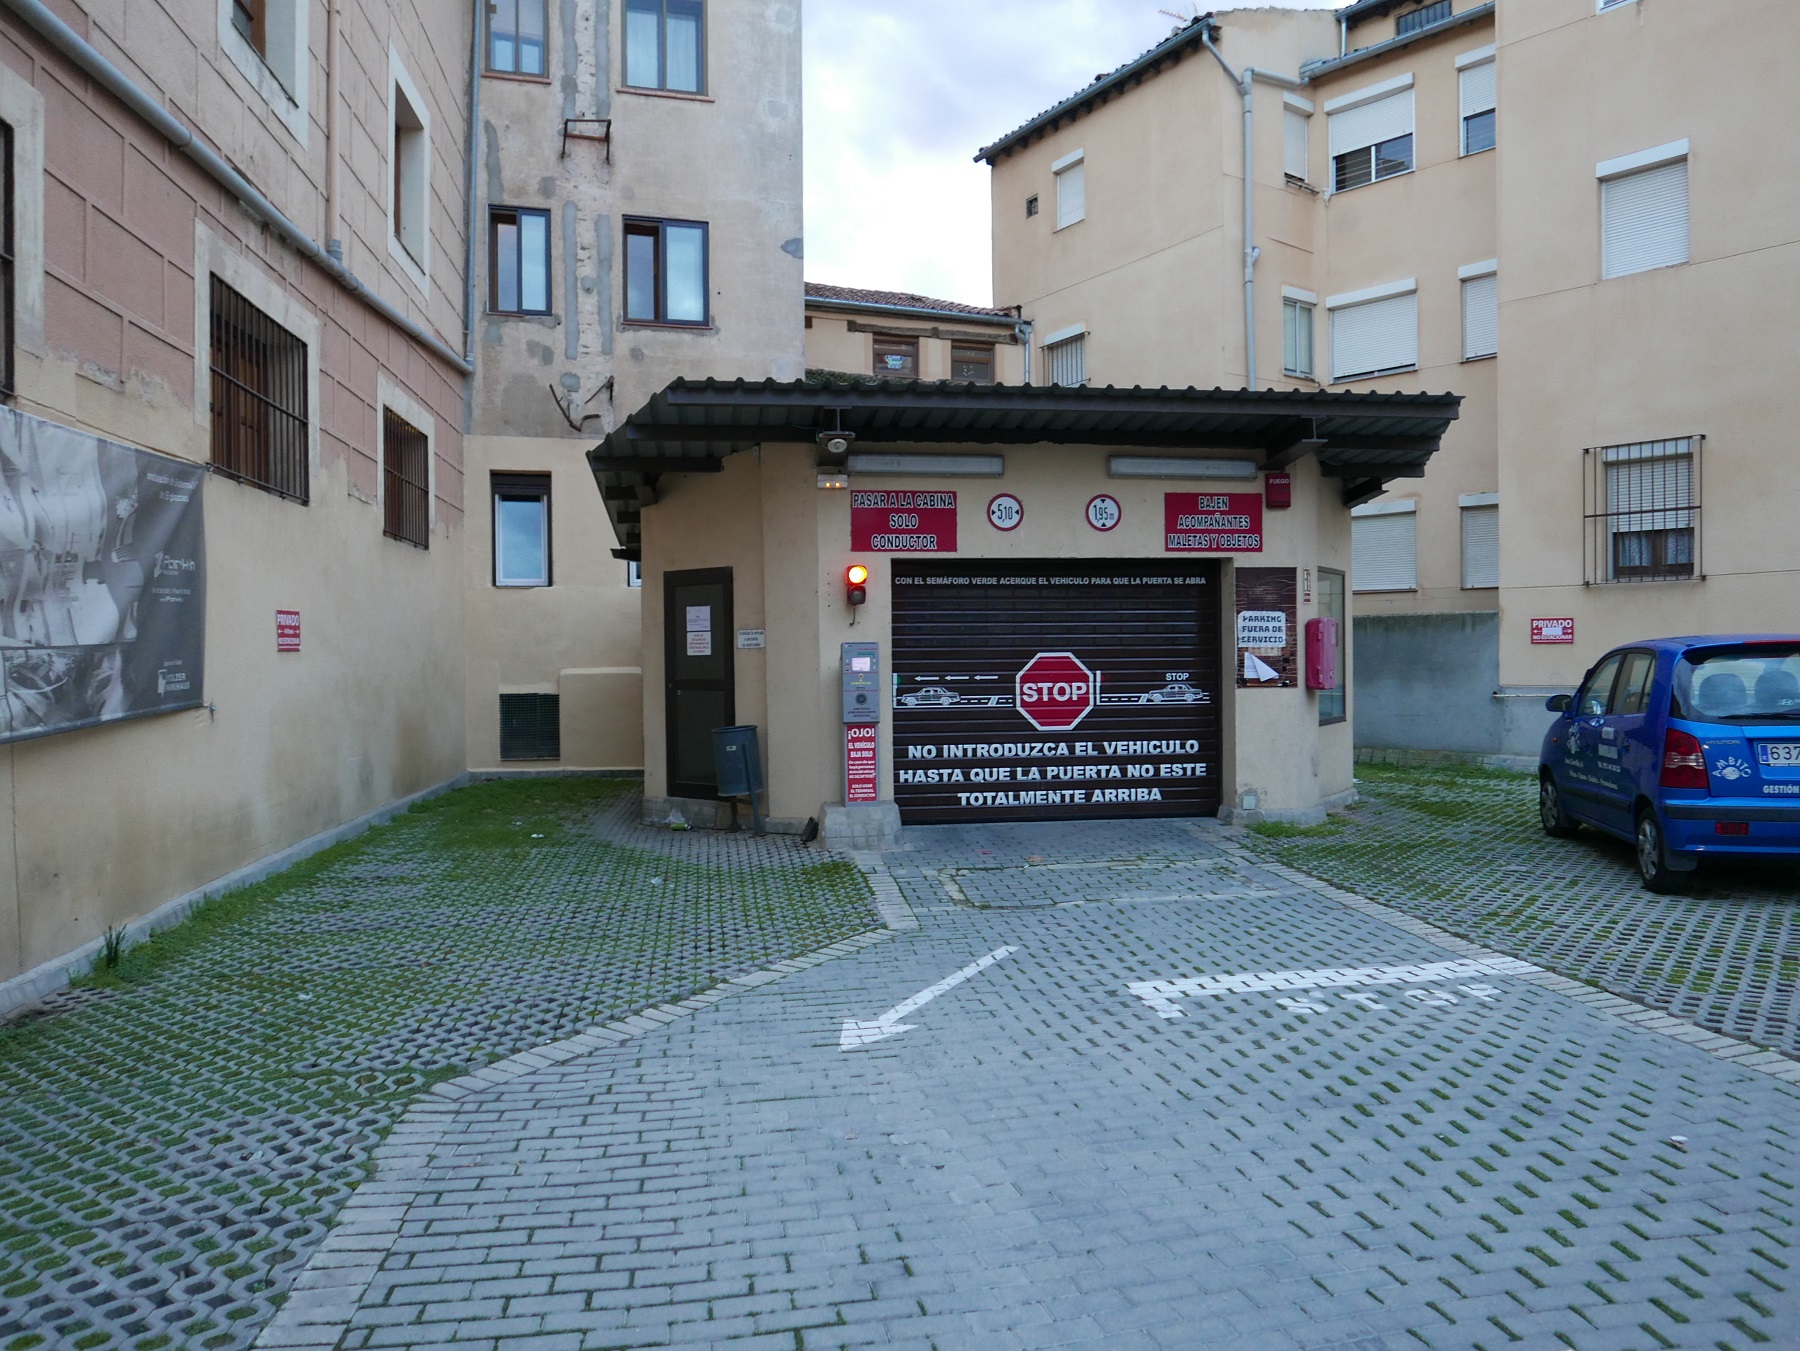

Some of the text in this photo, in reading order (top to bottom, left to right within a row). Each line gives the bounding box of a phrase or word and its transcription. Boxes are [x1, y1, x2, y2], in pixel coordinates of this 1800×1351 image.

[852, 494, 954, 508] PASAR A LA CABINA
[1198, 497, 1228, 510] BAJEN
[997, 504, 1013, 522] 5,10
[890, 514, 918, 528] SOLO
[1177, 512, 1250, 530] ACOMPAÑANTES
[871, 534, 937, 549] CONDUCTOR
[1168, 534, 1260, 548] MALETAS Y OBJETOS
[895, 576, 1206, 585] CON EL SEMÁFORO VERDE ACERQUE EL VEHICULO PARA QUE LA PUERTA SE ABRA
[1166, 672, 1189, 681] STOP
[1022, 682, 1087, 702] STOP
[848, 728, 874, 740] ¡OJO!
[908, 740, 1200, 759] NO INTRODUZCA EL VEHICULO
[900, 763, 1207, 784] HASTA QUE LA PUERTA NO ESTE
[1763, 784, 1800, 793] GESTIÓN
[957, 788, 1162, 807] TOTALMENTE ARRIBA
[1276, 984, 1502, 1014] STOP
